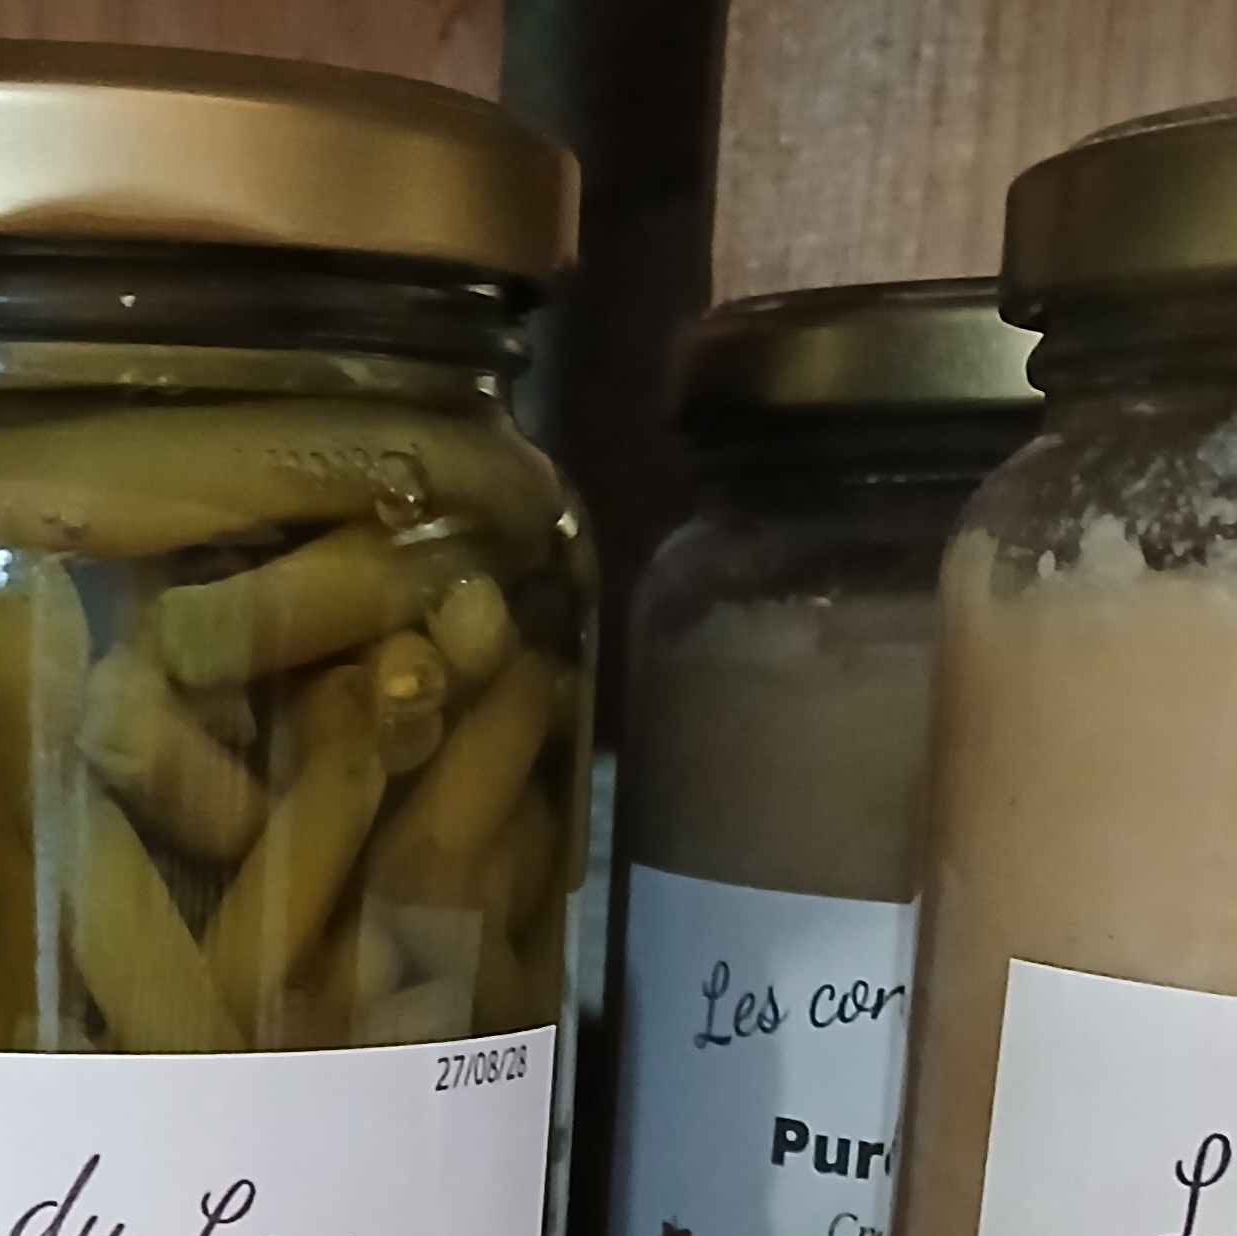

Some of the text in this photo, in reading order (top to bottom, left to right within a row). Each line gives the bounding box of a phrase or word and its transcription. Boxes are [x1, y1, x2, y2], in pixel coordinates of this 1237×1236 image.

[694, 960, 789, 1049] Les
[433, 1044, 528, 1092] 27/08/28
[770, 1116, 892, 1180] Pur
